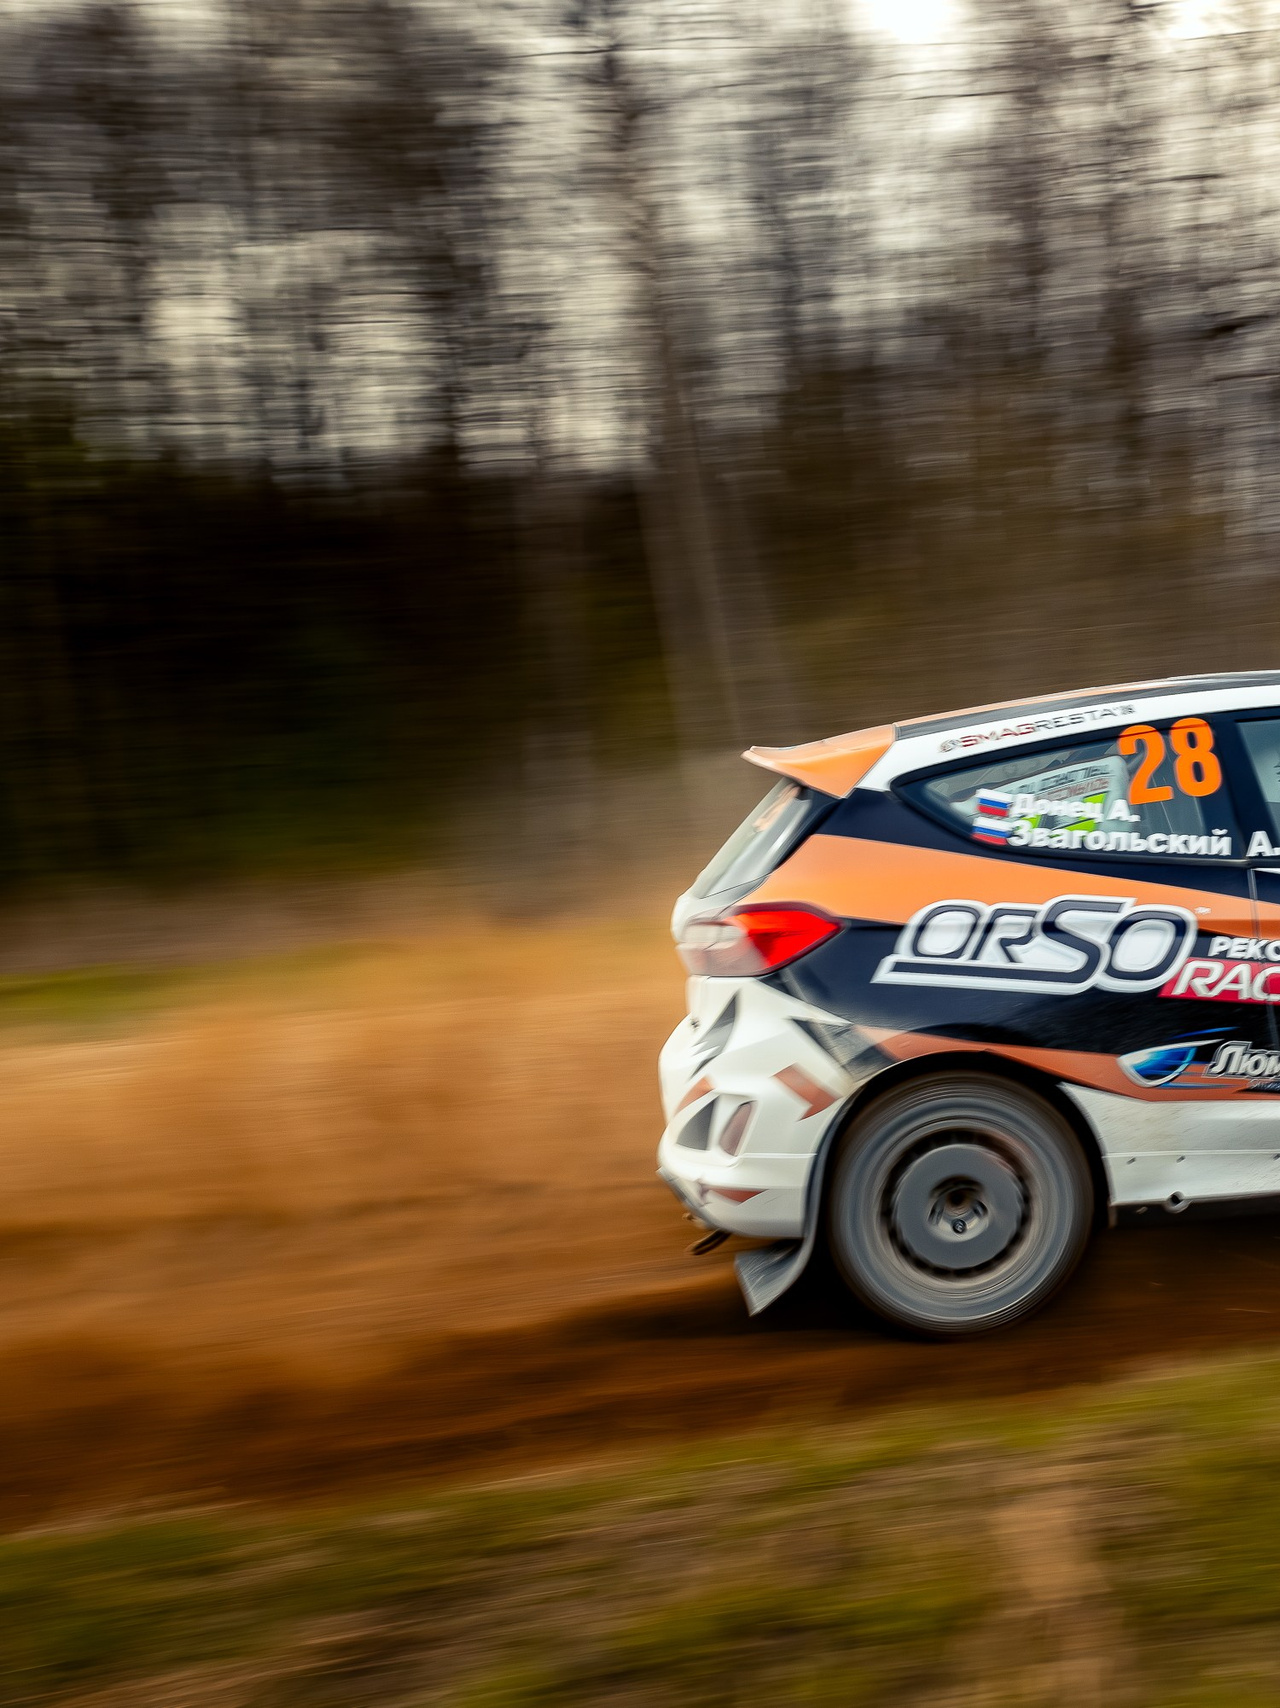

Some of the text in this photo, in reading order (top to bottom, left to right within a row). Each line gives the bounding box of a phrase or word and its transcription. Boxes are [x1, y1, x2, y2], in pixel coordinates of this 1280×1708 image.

[1117, 718, 1223, 806] 28
[1007, 819, 1232, 856] Звагольский
[1010, 793, 1141, 823] Донец А.
[870, 894, 1198, 996] ORSO
